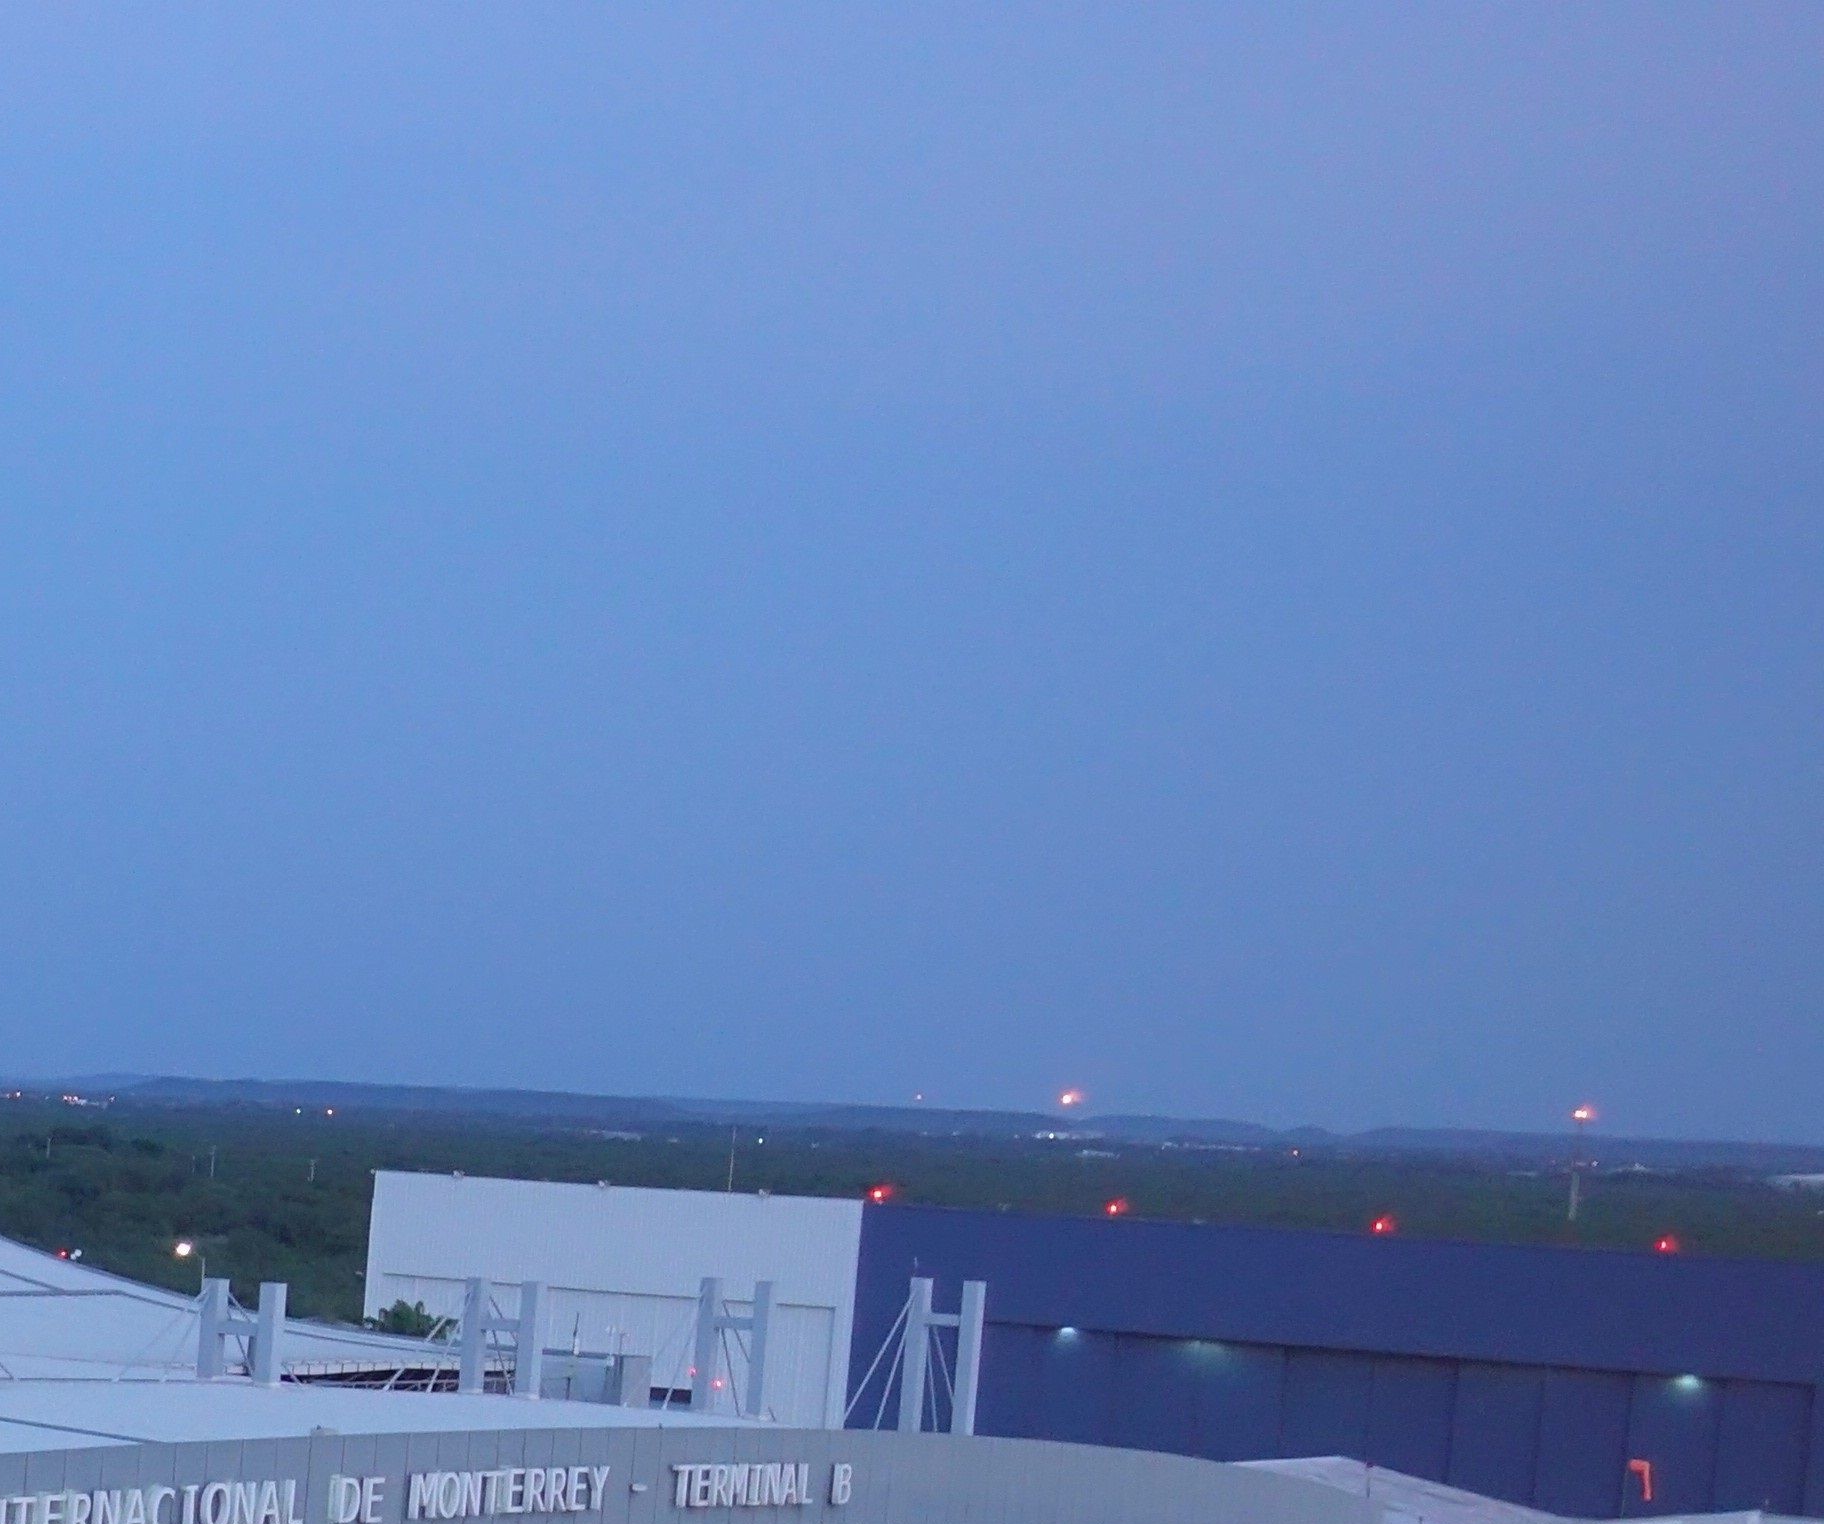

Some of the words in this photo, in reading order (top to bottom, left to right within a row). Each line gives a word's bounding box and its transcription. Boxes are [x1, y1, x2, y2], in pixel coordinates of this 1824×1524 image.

[329, 1473, 386, 1524] DE
[407, 1465, 610, 1520] MONTERREY
[671, 1462, 814, 1508] TERMINAL
[830, 1462, 853, 1506] B
